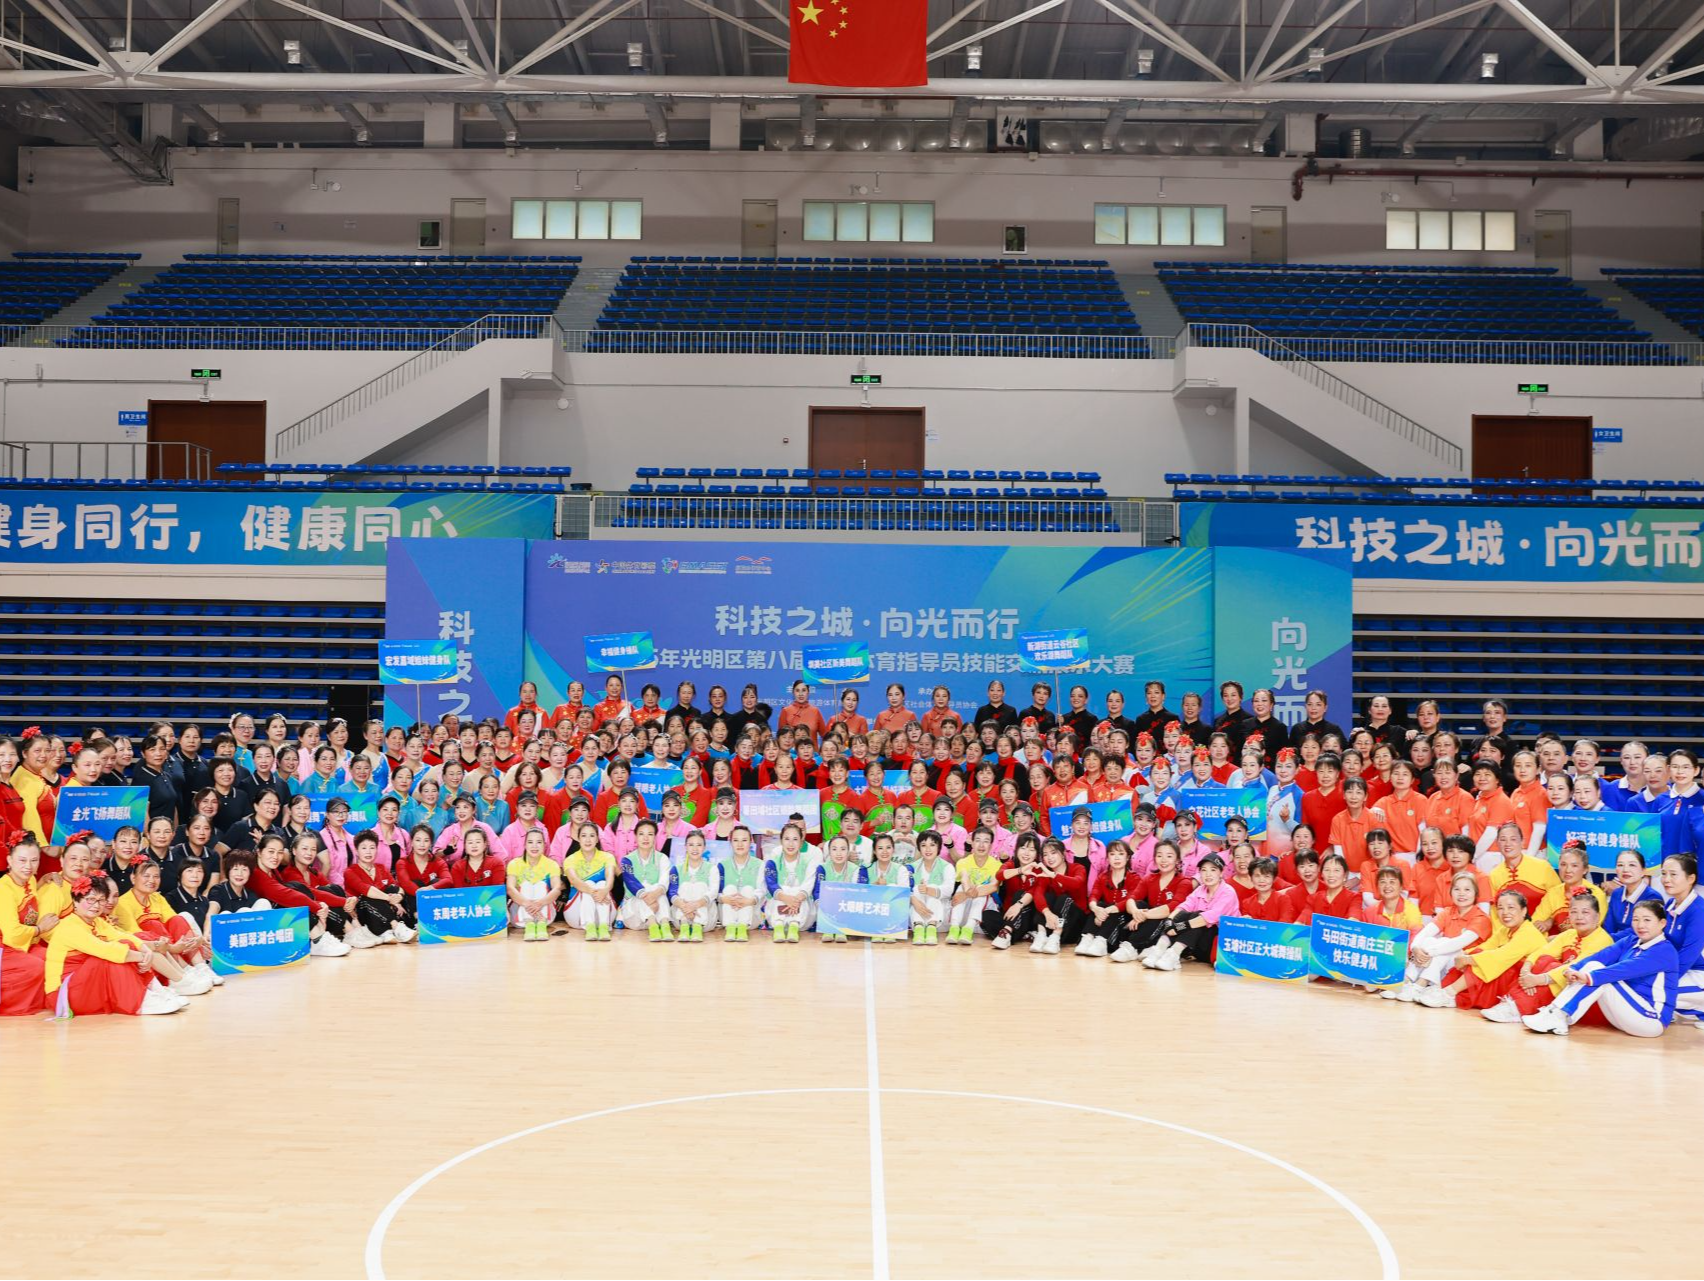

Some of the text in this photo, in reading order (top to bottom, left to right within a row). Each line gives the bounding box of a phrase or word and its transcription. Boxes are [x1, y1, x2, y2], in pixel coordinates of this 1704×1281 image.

[0, 503, 458, 553] 身同行，健康同心
[1295, 516, 1702, 568] 科技之城·向光而
[715, 604, 1020, 640] 科技之城·向光而行
[1271, 616, 1308, 727] 向光而
[634, 782, 676, 795] 碧眼老人协
[71, 806, 131, 821] 金光飞扬舞蹈队
[1566, 831, 1641, 849] 好运来健身操队
[433, 904, 492, 920] 东周老年人协会
[838, 900, 890, 916] 大眼睛艺术团
[229, 928, 295, 948] 美丽翠湖合唱团
[1321, 928, 1395, 956] 马田街道南庄三区
[1333, 948, 1378, 971] 快乐健身队
